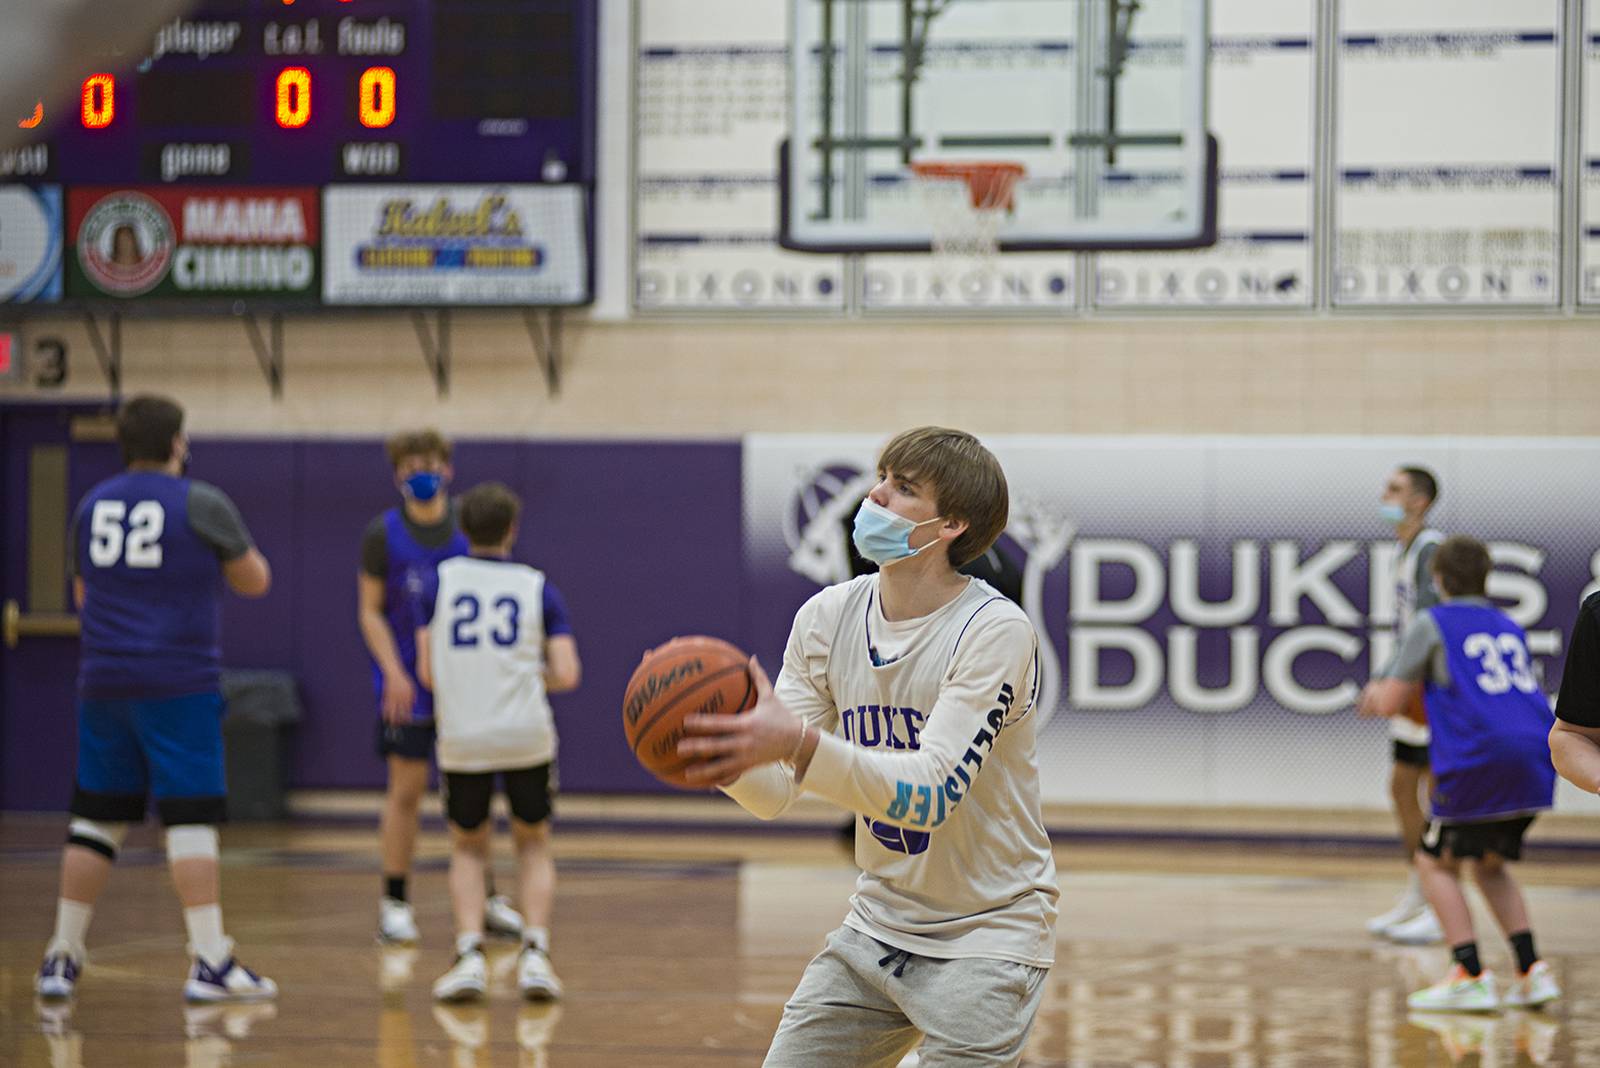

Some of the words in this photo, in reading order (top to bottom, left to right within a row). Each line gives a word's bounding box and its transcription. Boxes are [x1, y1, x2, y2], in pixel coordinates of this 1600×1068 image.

[82, 73, 114, 128] 0
[275, 67, 311, 128] 0
[359, 67, 396, 128] 0
[183, 198, 306, 240] MAMA
[173, 245, 315, 290] CIMINO
[1097, 267, 1268, 302] DIXON
[1338, 265, 1510, 301] DIXON
[35, 337, 68, 387] 3
[90, 500, 165, 568] 52
[451, 594, 521, 648] 23
[1463, 632, 1538, 695] 33
[842, 705, 929, 751] DUKE
